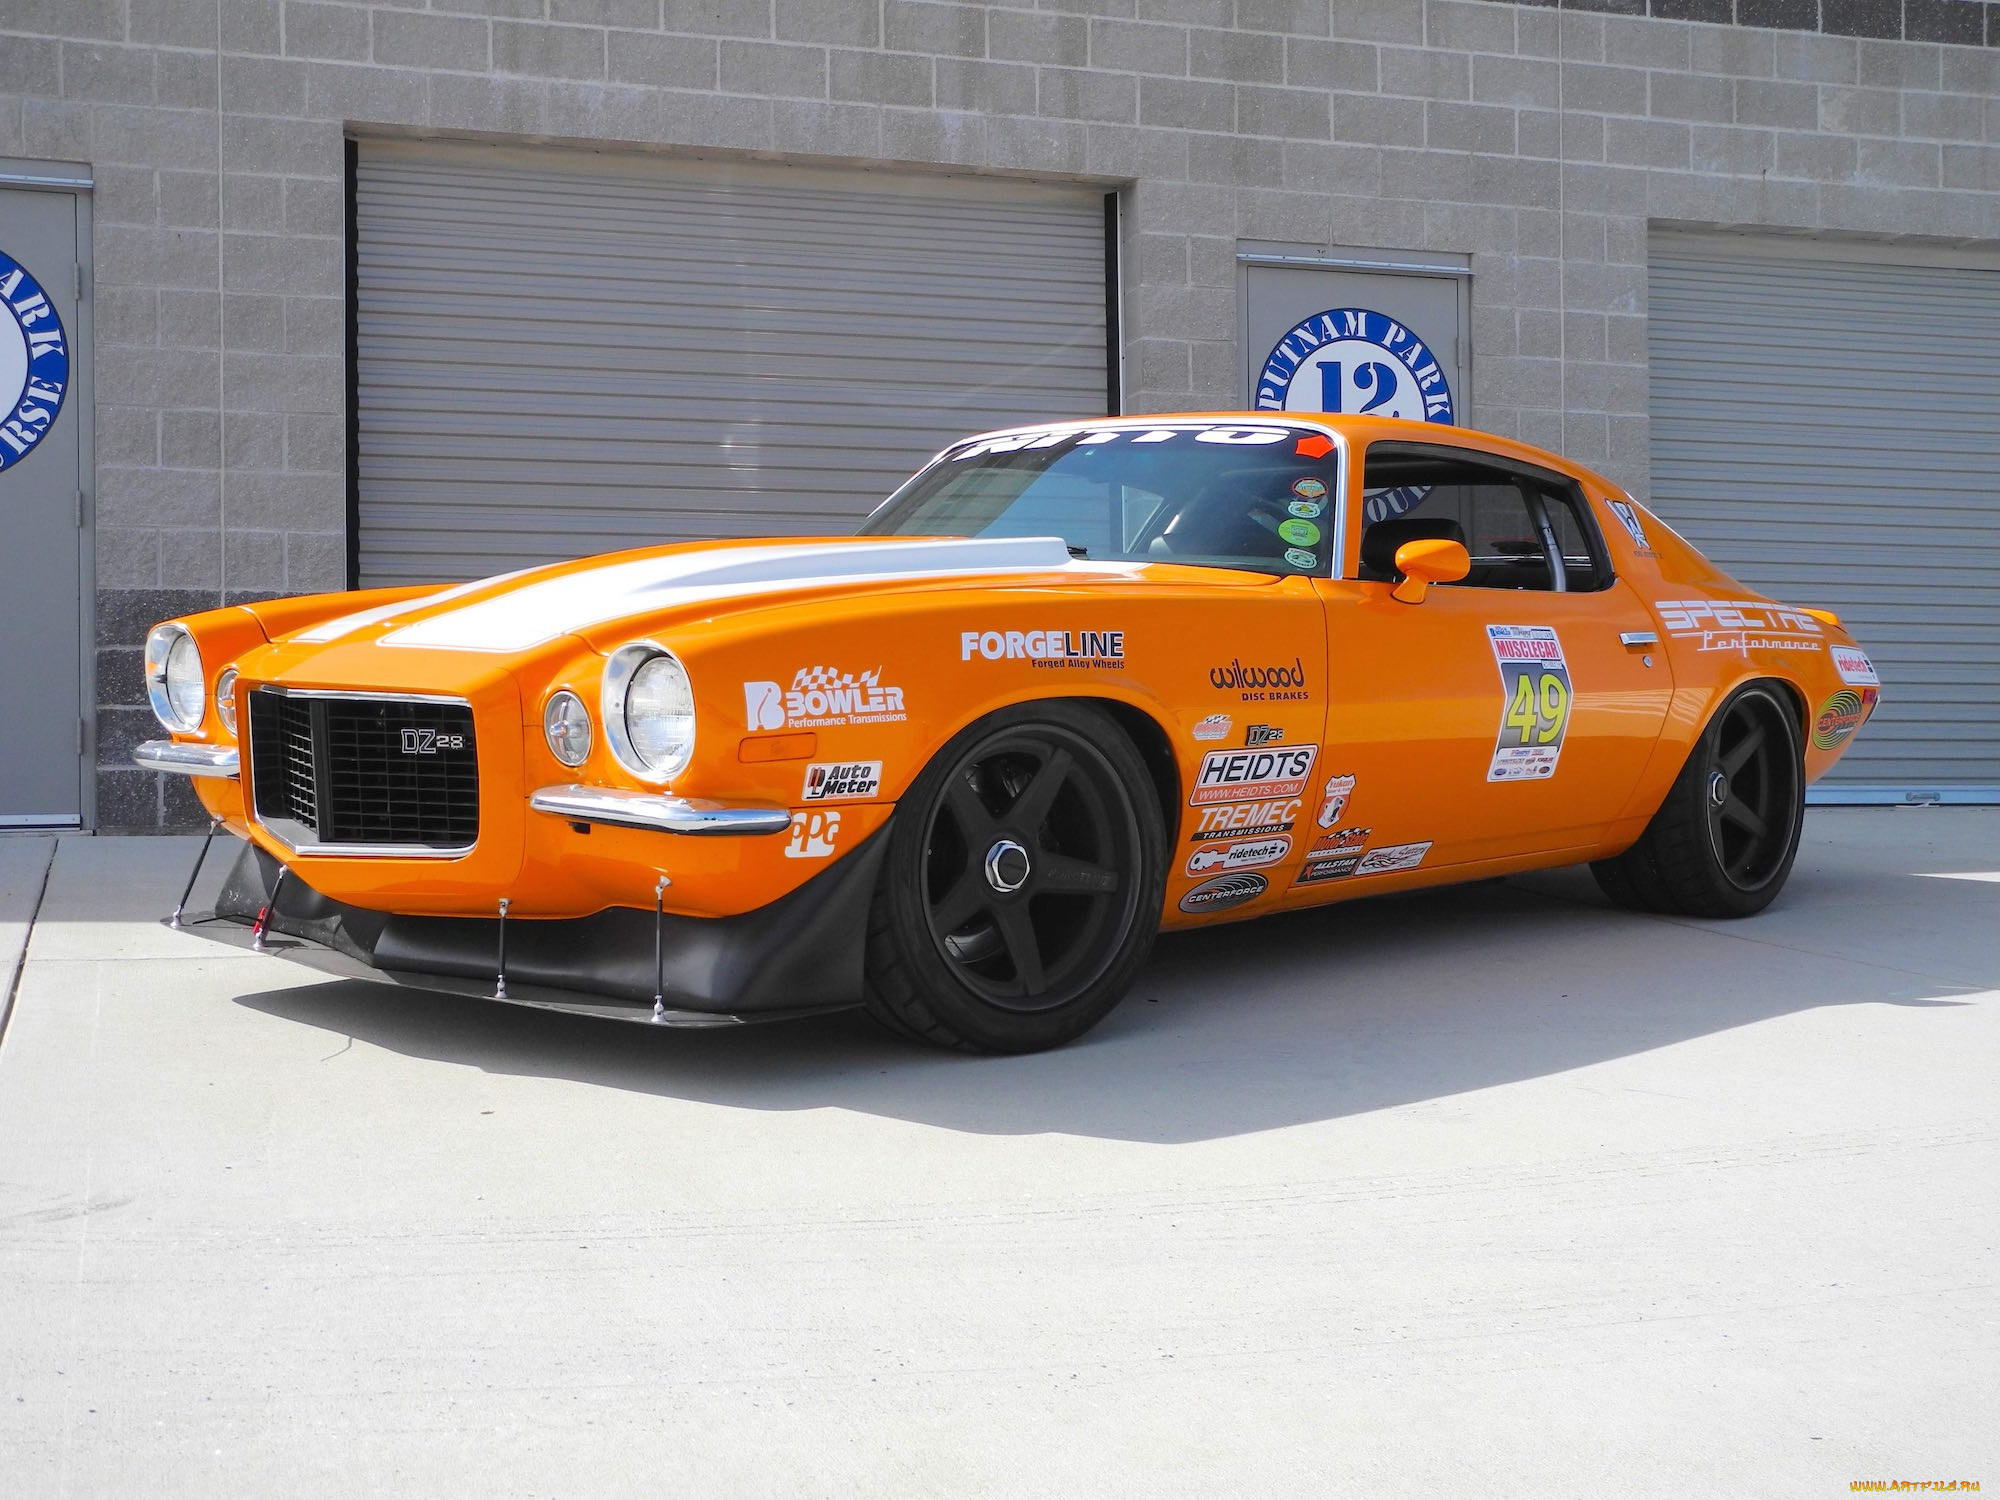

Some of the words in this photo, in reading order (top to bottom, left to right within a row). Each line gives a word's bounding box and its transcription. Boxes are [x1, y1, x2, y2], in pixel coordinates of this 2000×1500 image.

[1258, 311, 1368, 411] PUTNAM
[1381, 322, 1451, 418] PARK
[1316, 361, 1400, 418] 12
[0, 376, 64, 467] RSE
[961, 630, 1126, 661] FORGELINE
[1495, 640, 1560, 658] MUSCLECAR
[1697, 630, 1822, 658] Performance
[1032, 658, 1065, 670] Forged
[1068, 658, 1090, 671] Alloy
[1093, 658, 1125, 670] Wheels
[1209, 658, 1305, 689] wilwood
[785, 686, 906, 718] BOWLER
[1242, 692, 1265, 701] DISC
[1269, 691, 1309, 700] BRAKES
[1506, 673, 1568, 744] 49
[788, 716, 847, 729] Performance
[848, 712, 907, 725] Transmissions
[828, 764, 872, 780] Auto
[1202, 750, 1310, 784] HEIDTS
[823, 779, 878, 797] Meter
[1199, 783, 1298, 800] WWW.HEIDTS.COM
[1198, 799, 1302, 832] TREMEC
[1203, 824, 1285, 839] TRANSMISSIONS
[1229, 846, 1268, 860] ridetech
[1313, 858, 1358, 870] ALLSTAR
[1188, 885, 1265, 903] CENTERFORCE
